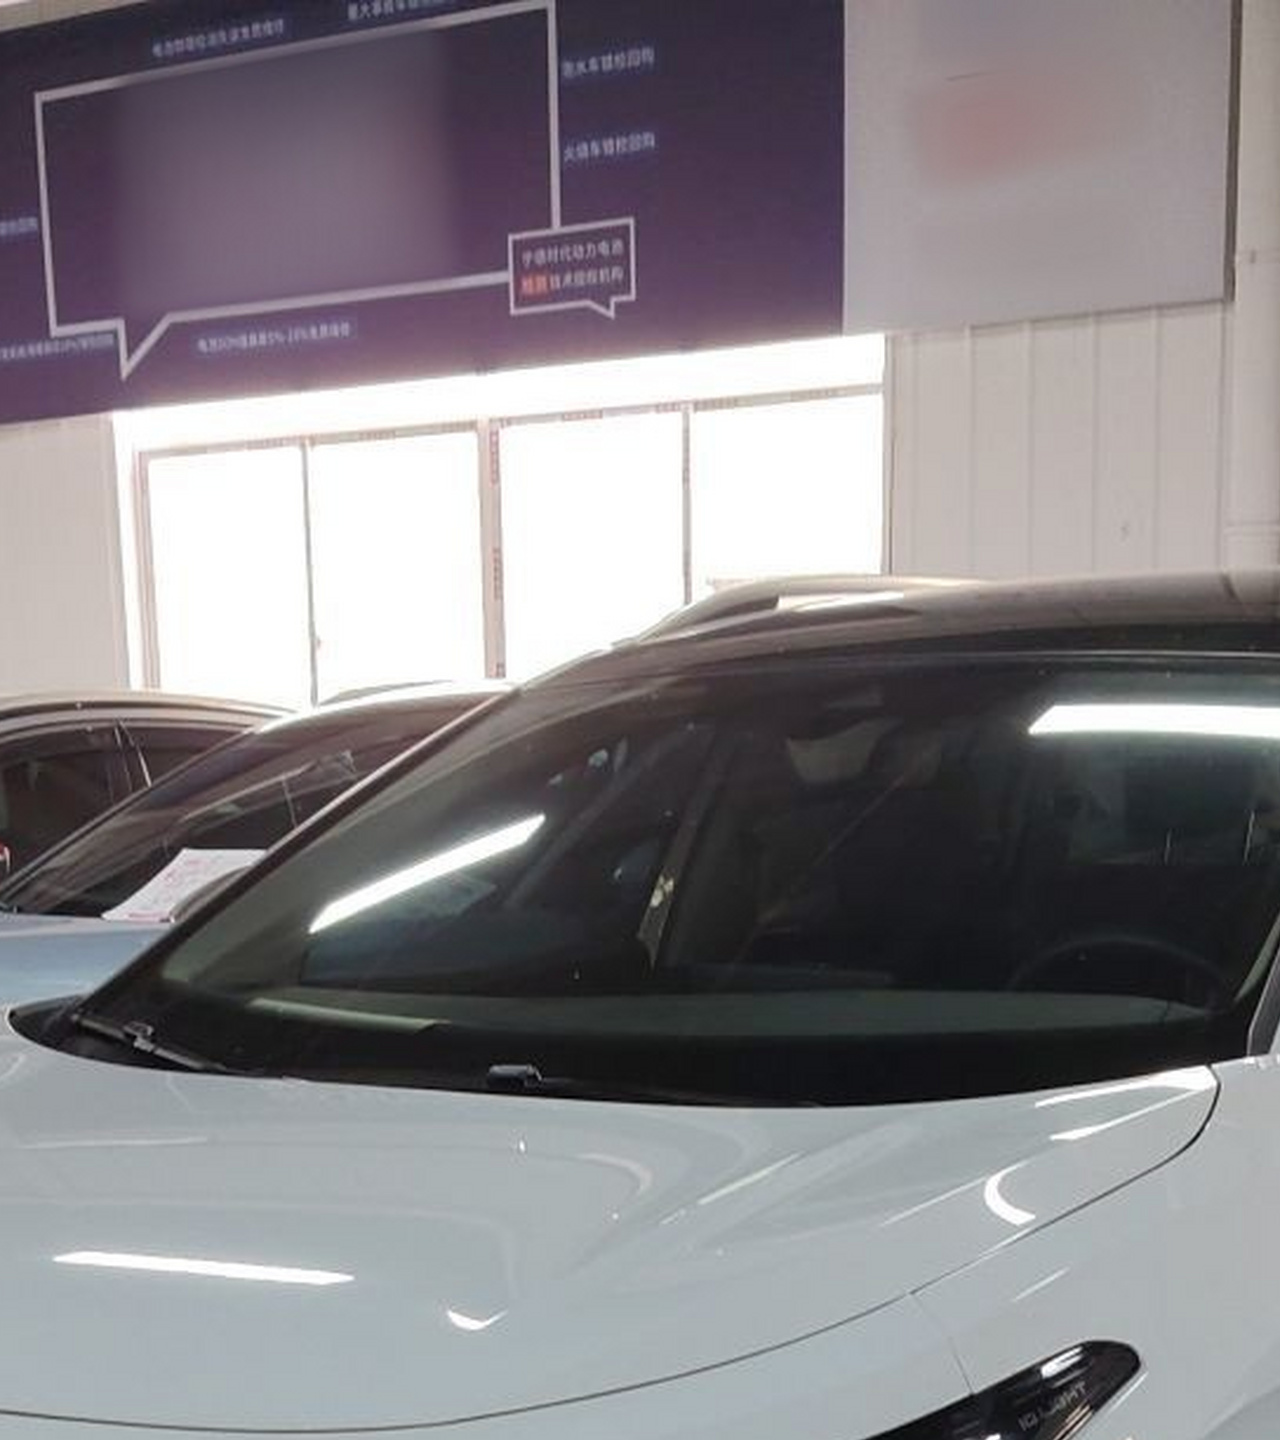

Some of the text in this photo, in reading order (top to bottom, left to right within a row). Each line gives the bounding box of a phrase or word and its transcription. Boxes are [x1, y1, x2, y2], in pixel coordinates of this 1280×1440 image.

[522, 239, 624, 268] 宁德时代动力电池
